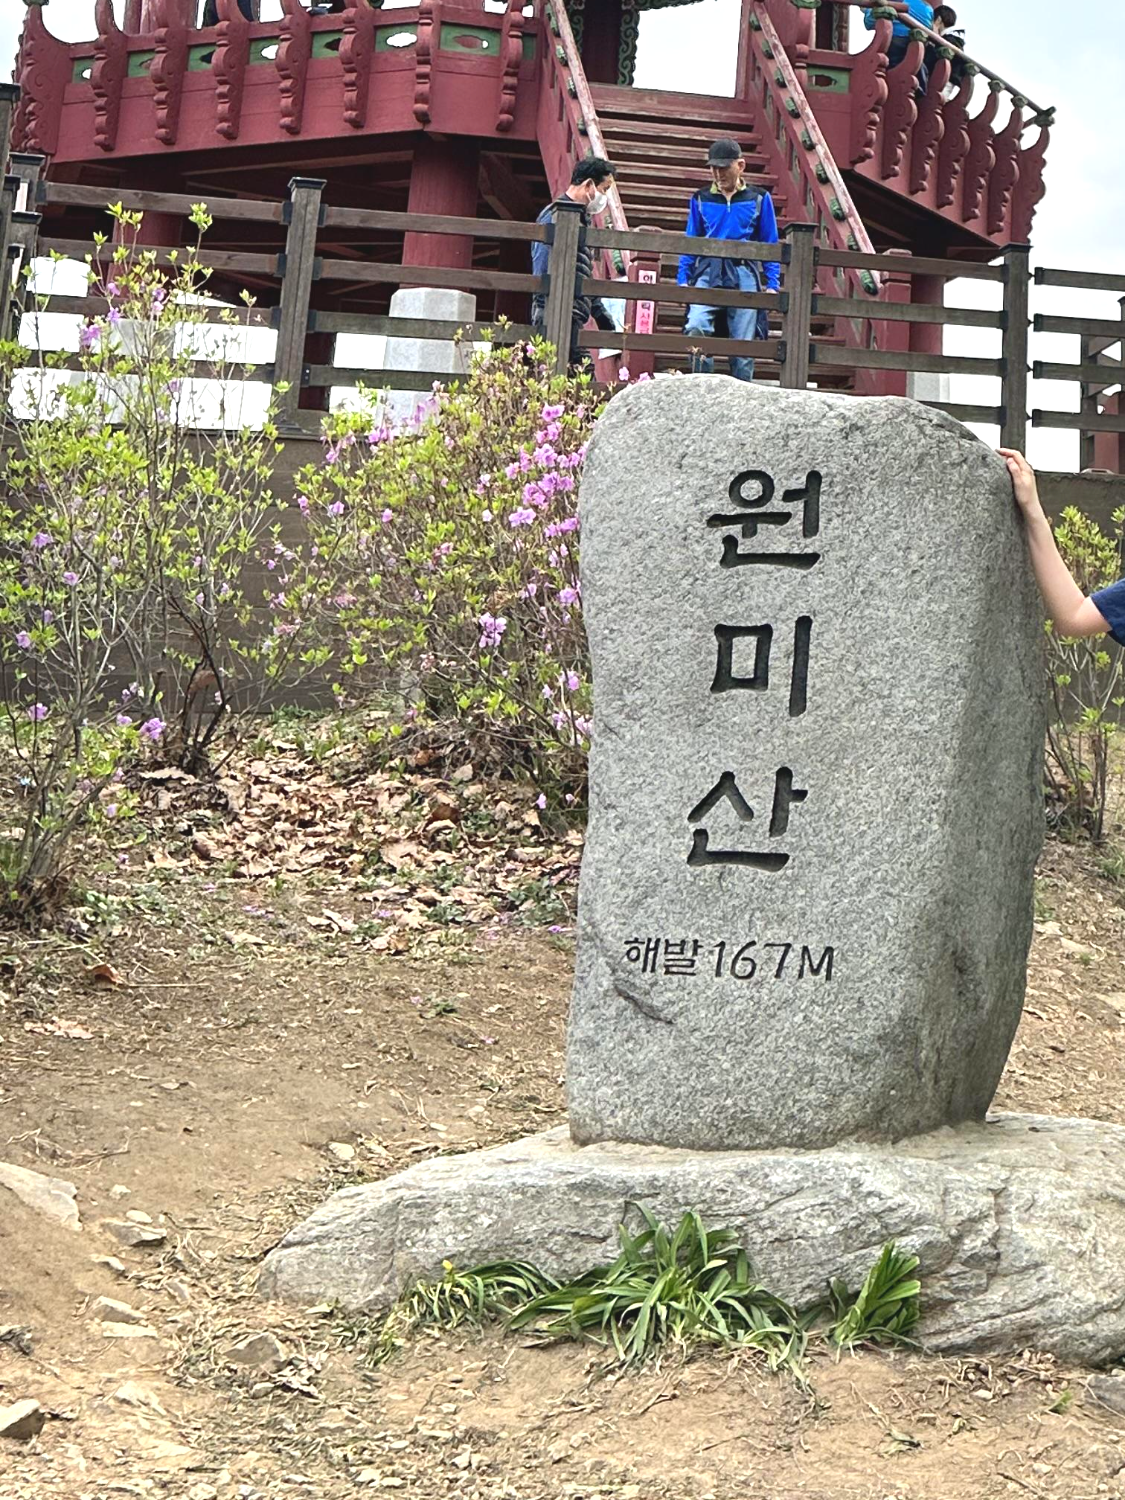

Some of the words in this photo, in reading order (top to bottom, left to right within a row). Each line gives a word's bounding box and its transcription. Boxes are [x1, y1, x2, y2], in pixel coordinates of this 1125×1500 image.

[686, 468, 823, 873] 원미산
[624, 937, 704, 976] 해발
[713, 940, 835, 982] 167M
